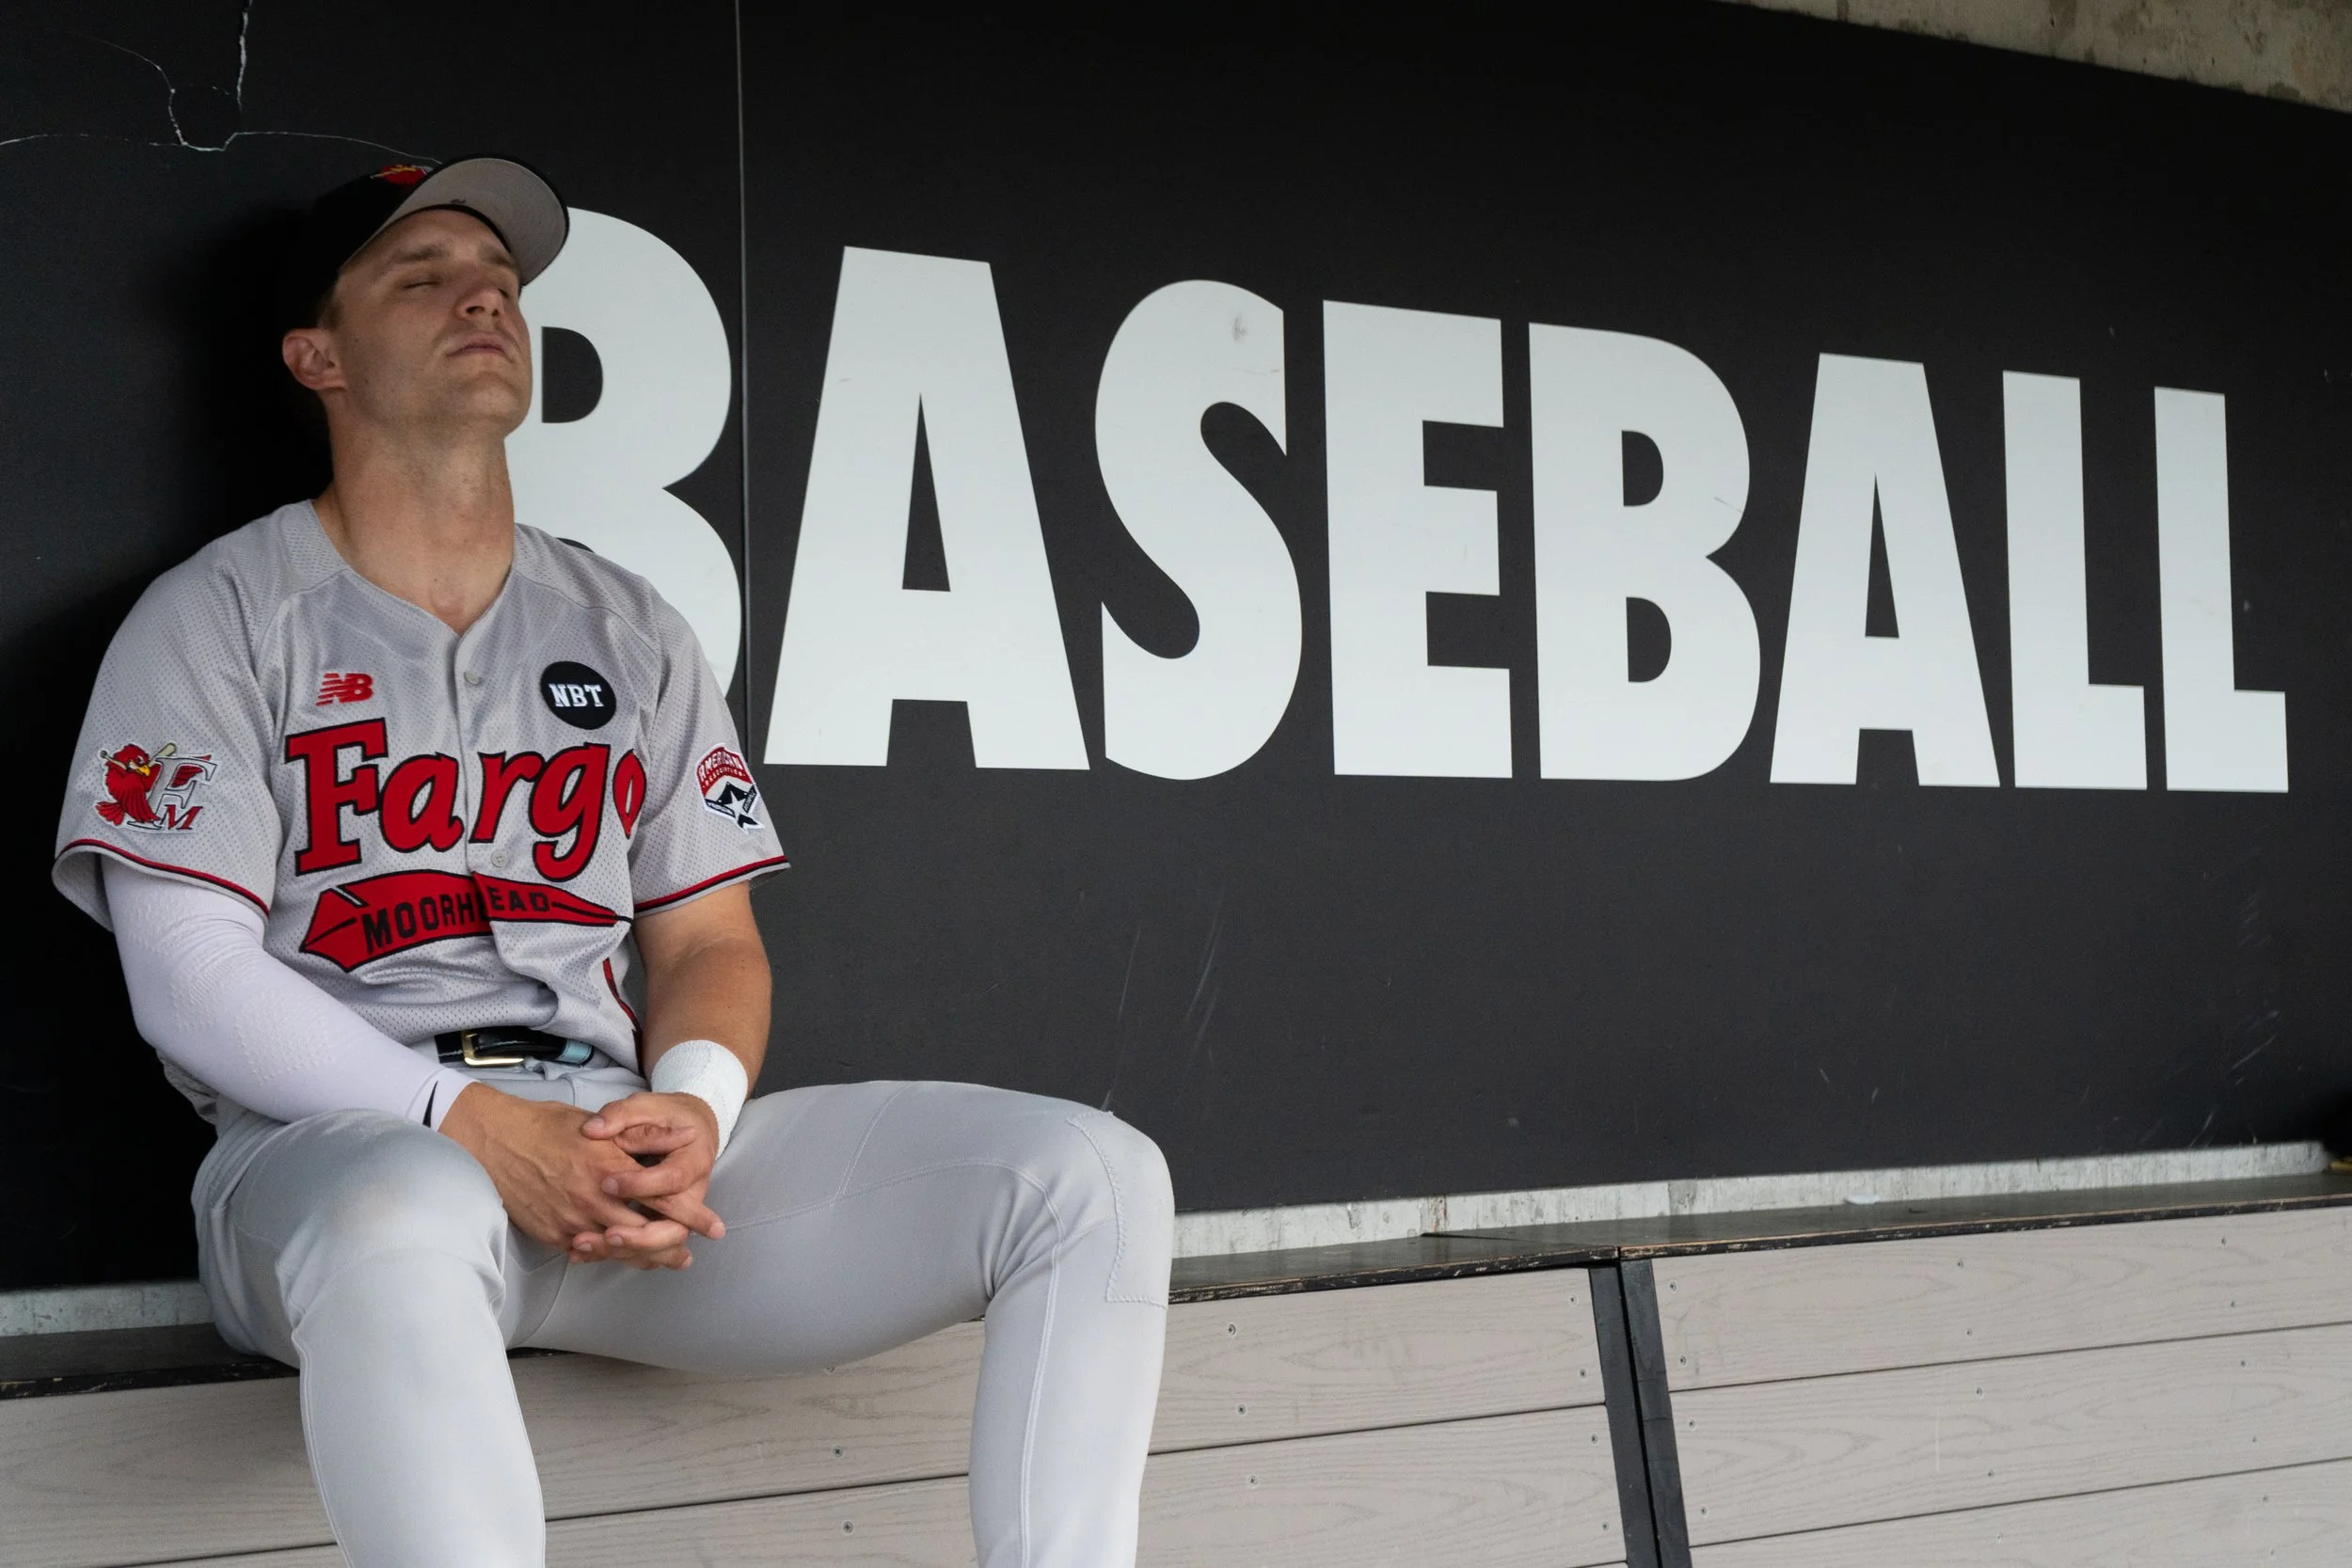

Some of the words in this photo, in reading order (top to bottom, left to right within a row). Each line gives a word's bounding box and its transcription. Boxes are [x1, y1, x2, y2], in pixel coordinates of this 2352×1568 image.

[504, 206, 2288, 793] BASEBALL
[315, 673, 373, 705] NB
[548, 683, 605, 707] NBT
[284, 718, 647, 882] Fargo
[361, 886, 549, 955] MOORHEAD
